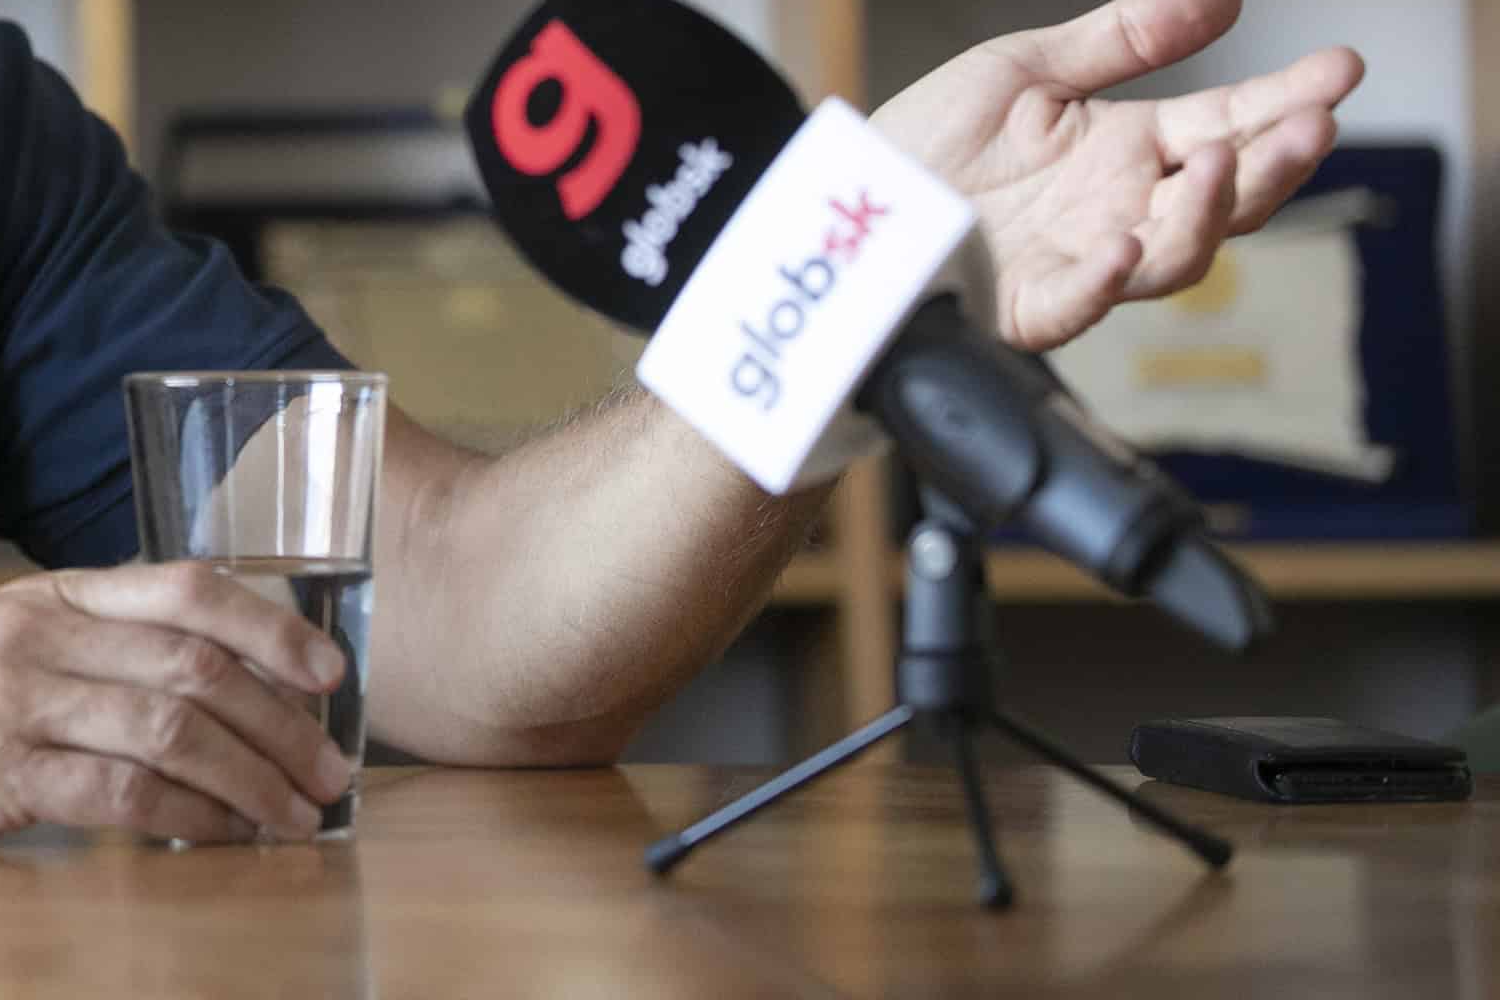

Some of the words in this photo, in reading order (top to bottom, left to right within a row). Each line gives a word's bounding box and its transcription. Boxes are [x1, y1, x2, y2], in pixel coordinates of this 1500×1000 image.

[492, 19, 642, 220] g
[621, 137, 734, 286] globsk
[731, 190, 889, 411] globsk
